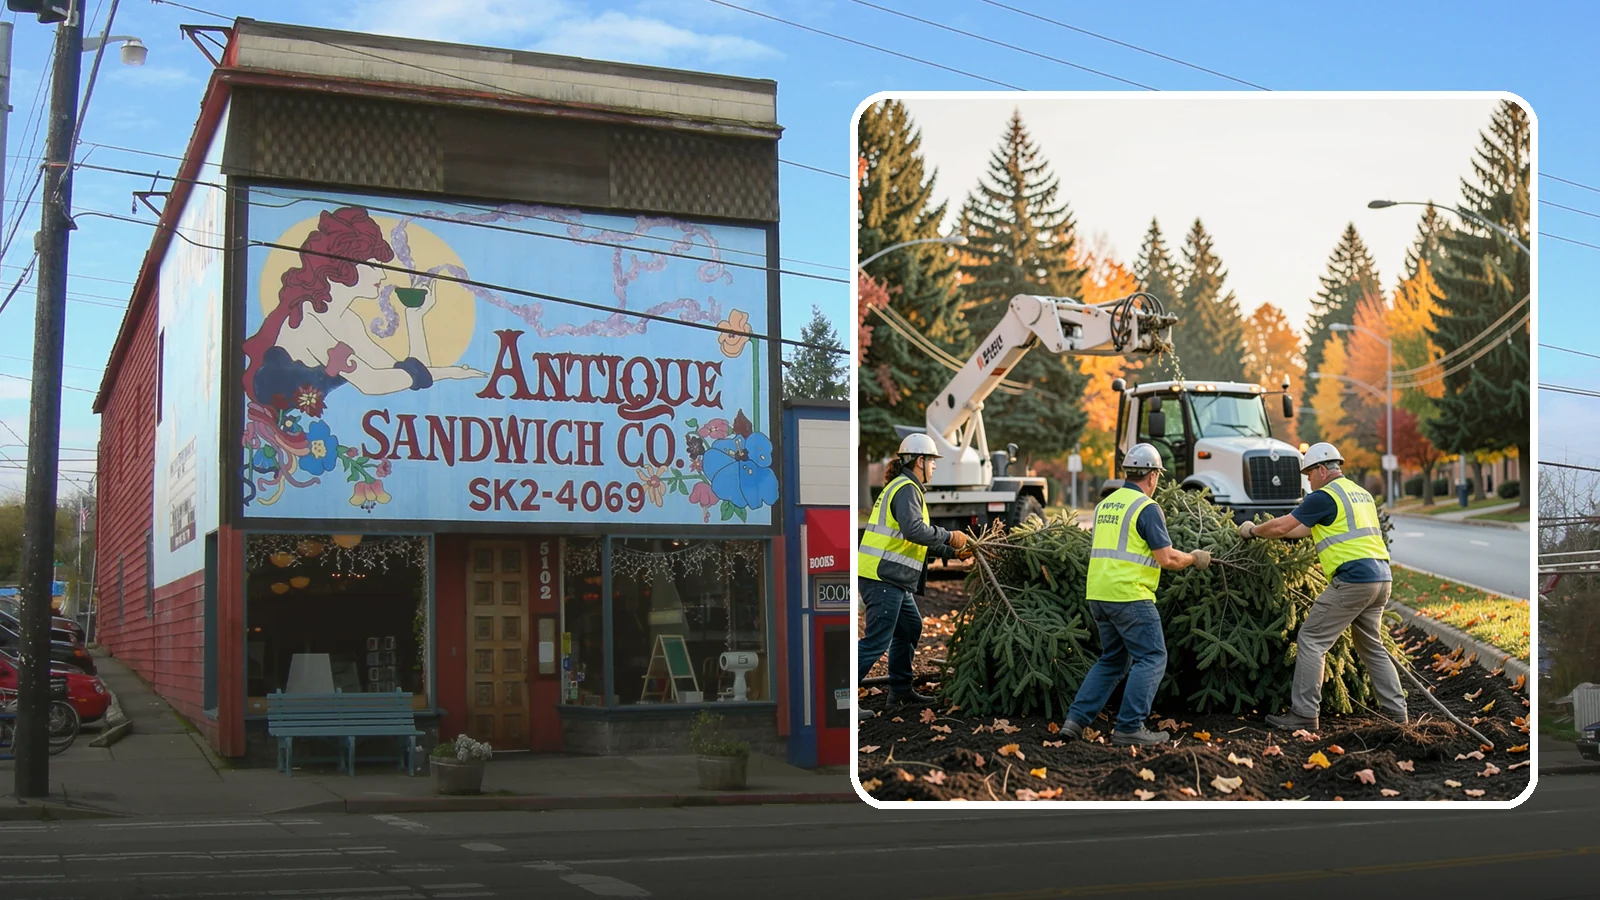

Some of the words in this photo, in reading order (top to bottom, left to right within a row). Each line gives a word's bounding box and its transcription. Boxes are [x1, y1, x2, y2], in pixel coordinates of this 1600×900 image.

[476, 329, 723, 420] ANTIQUE
[361, 409, 605, 468] SANDWICH
[617, 422, 685, 469] CO.
[468, 477, 646, 513] SK2-4069
[540, 542, 551, 600] 5102
[809, 555, 834, 569] BOOKS
